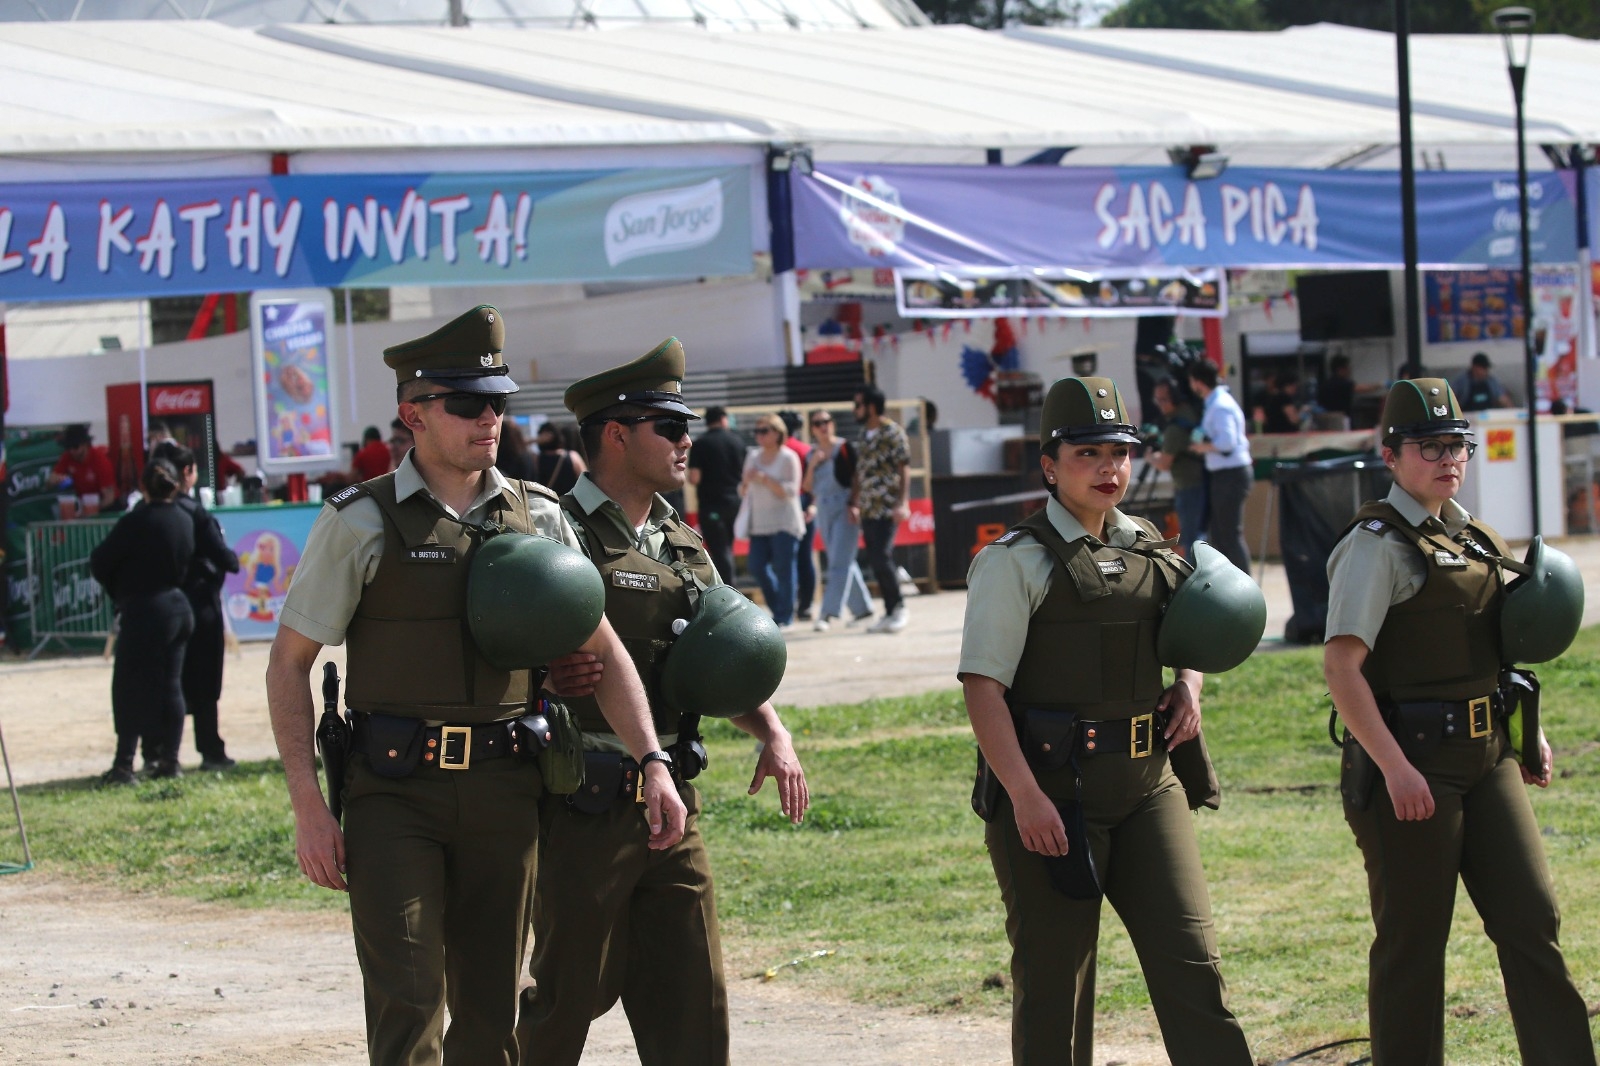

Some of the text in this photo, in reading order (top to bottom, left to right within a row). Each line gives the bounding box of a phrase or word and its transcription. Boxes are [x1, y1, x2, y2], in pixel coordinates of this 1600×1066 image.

[0, 188, 532, 281] LA KATHY INVITA!
[612, 204, 714, 242] San Jorge
[1095, 181, 1319, 251] SACA PICA
[155, 389, 203, 410] Coca-Cola
[440, 551, 447, 559] V.
